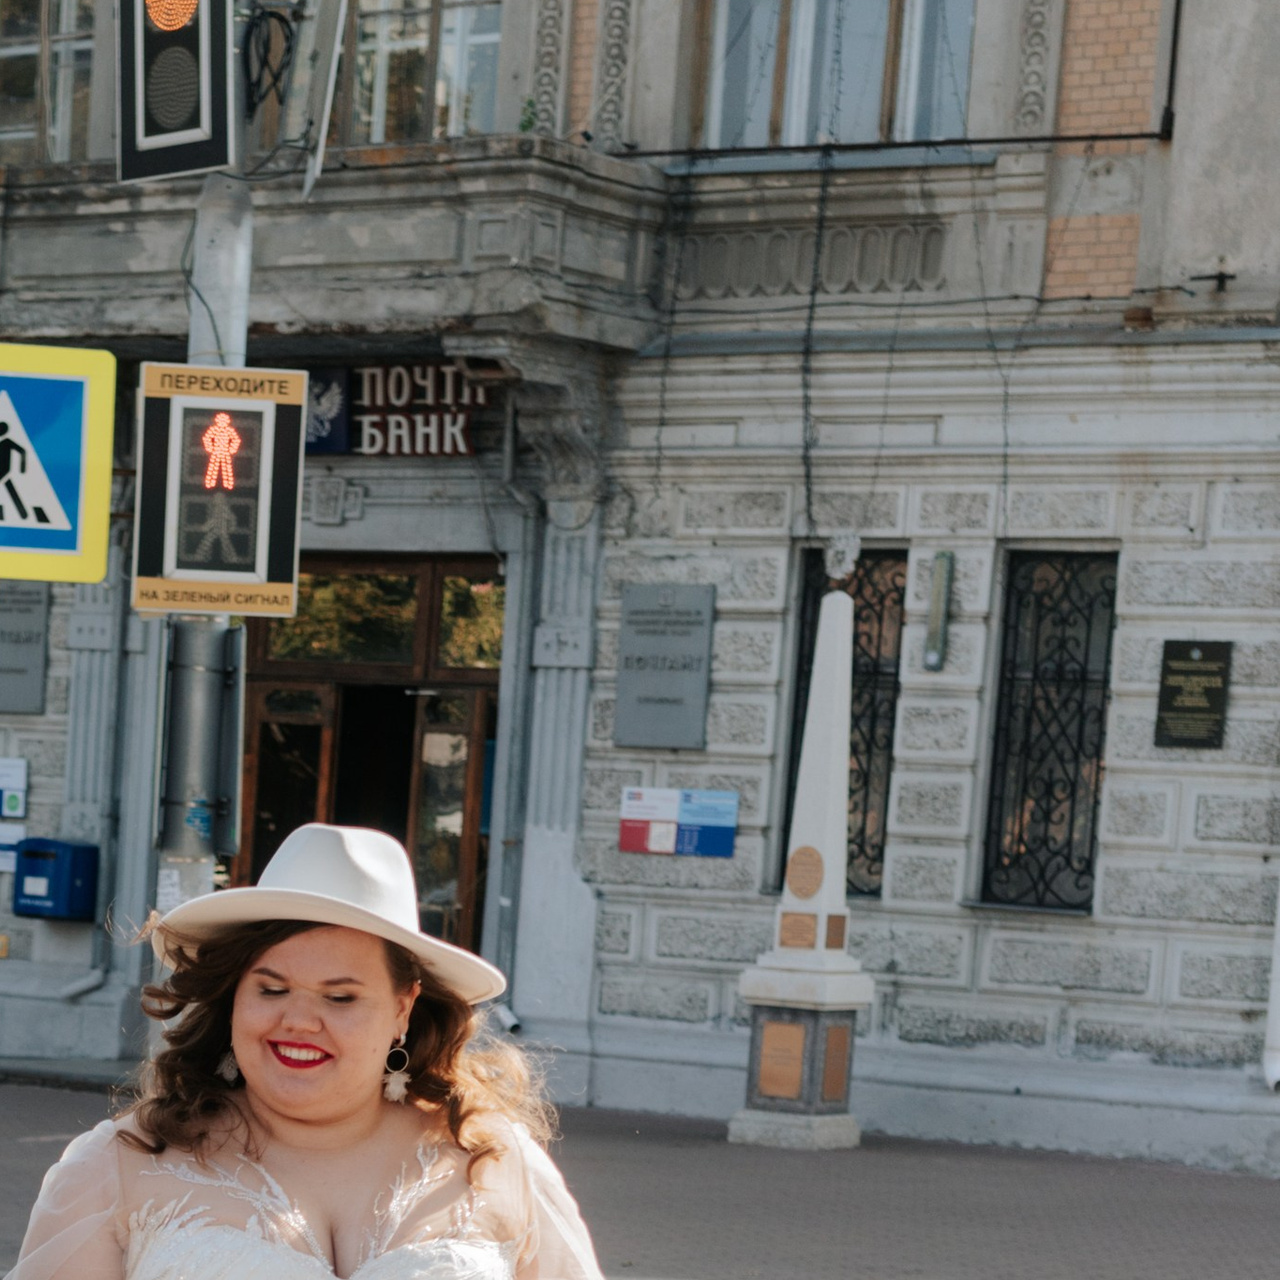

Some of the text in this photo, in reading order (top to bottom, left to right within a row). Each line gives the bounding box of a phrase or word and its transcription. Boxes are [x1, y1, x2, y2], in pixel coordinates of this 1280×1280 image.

[160, 373, 289, 395] ПЕРЕХОДИТЕ
[354, 412, 468, 455] БАНК
[139, 590, 158, 600] НА
[234, 593, 290, 606] СИГНАЛ
